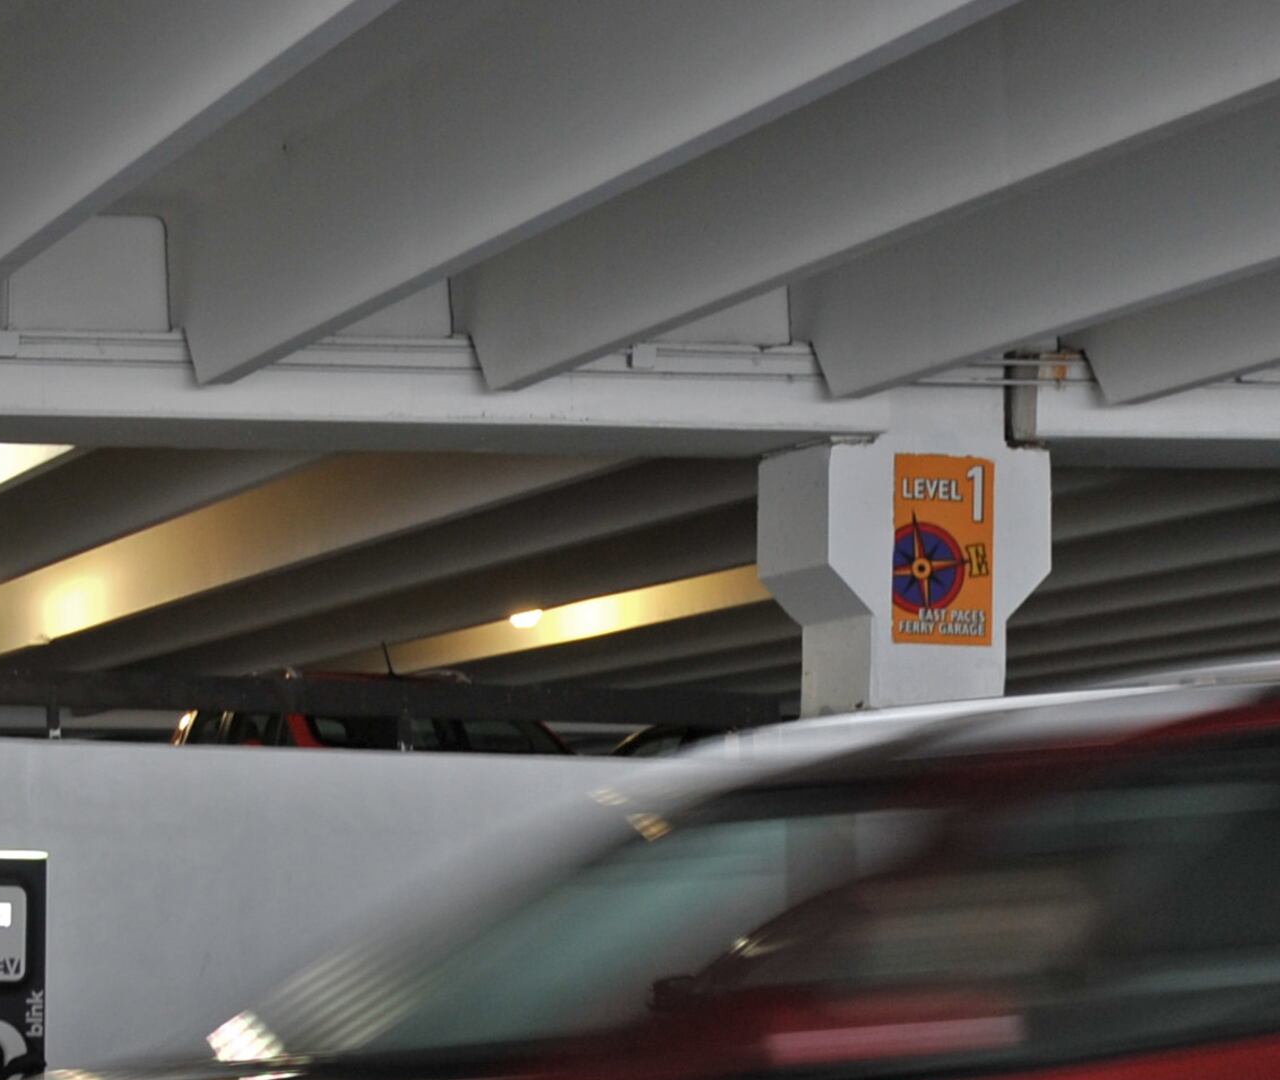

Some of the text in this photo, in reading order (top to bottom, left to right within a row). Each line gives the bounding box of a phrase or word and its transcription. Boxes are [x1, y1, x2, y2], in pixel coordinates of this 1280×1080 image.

[902, 465, 985, 524] LEVEL 1
[966, 543, 989, 578] E
[899, 620, 985, 637] FERRY GARAGE
[918, 608, 985, 623] EAST PACES
[26, 989, 44, 1038] blink
